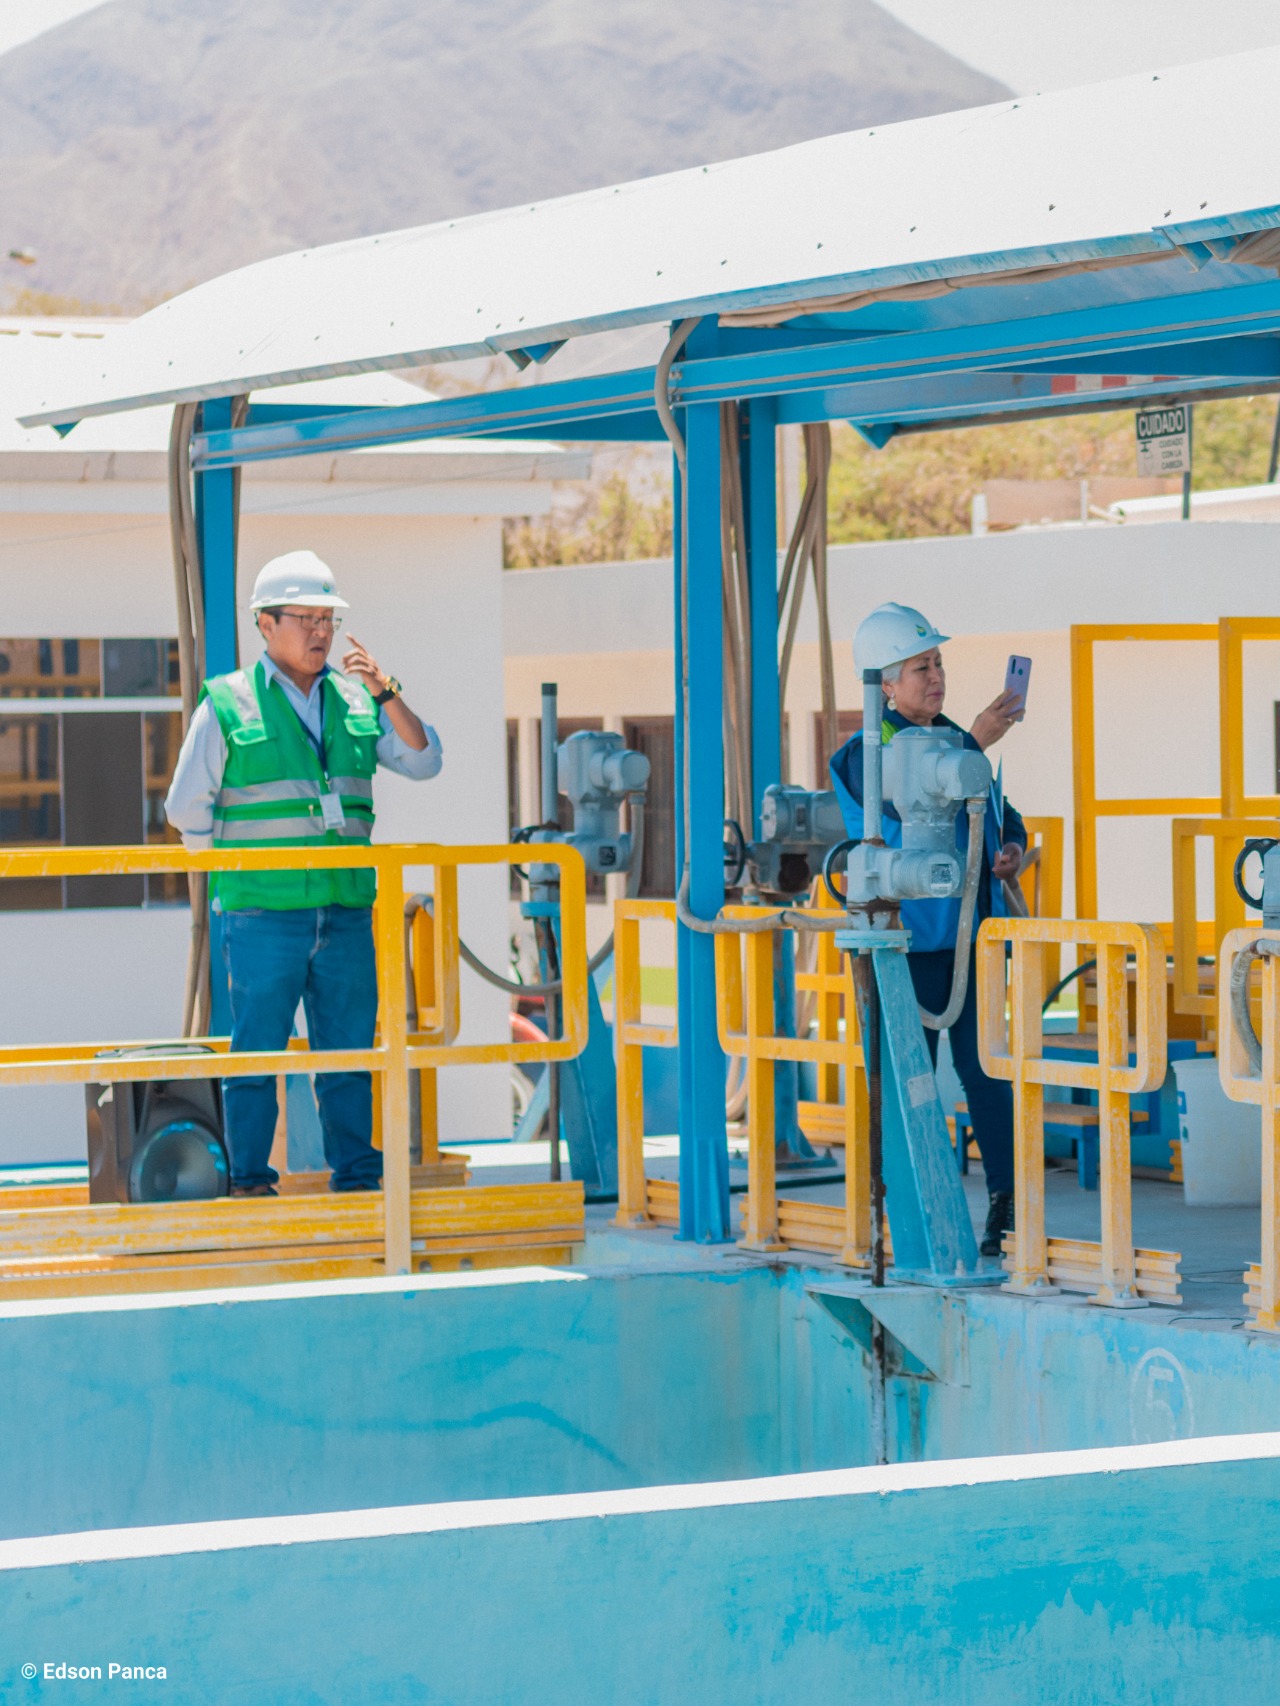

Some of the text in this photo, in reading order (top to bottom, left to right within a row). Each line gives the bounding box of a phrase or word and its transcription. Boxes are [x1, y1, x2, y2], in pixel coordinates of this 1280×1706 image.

[1138, 409, 1184, 437] CUIDADO
[1159, 437, 1184, 448] CUIDADO
[1161, 449, 1182, 459] CON LA
[1161, 460, 1183, 470] CABEZA
